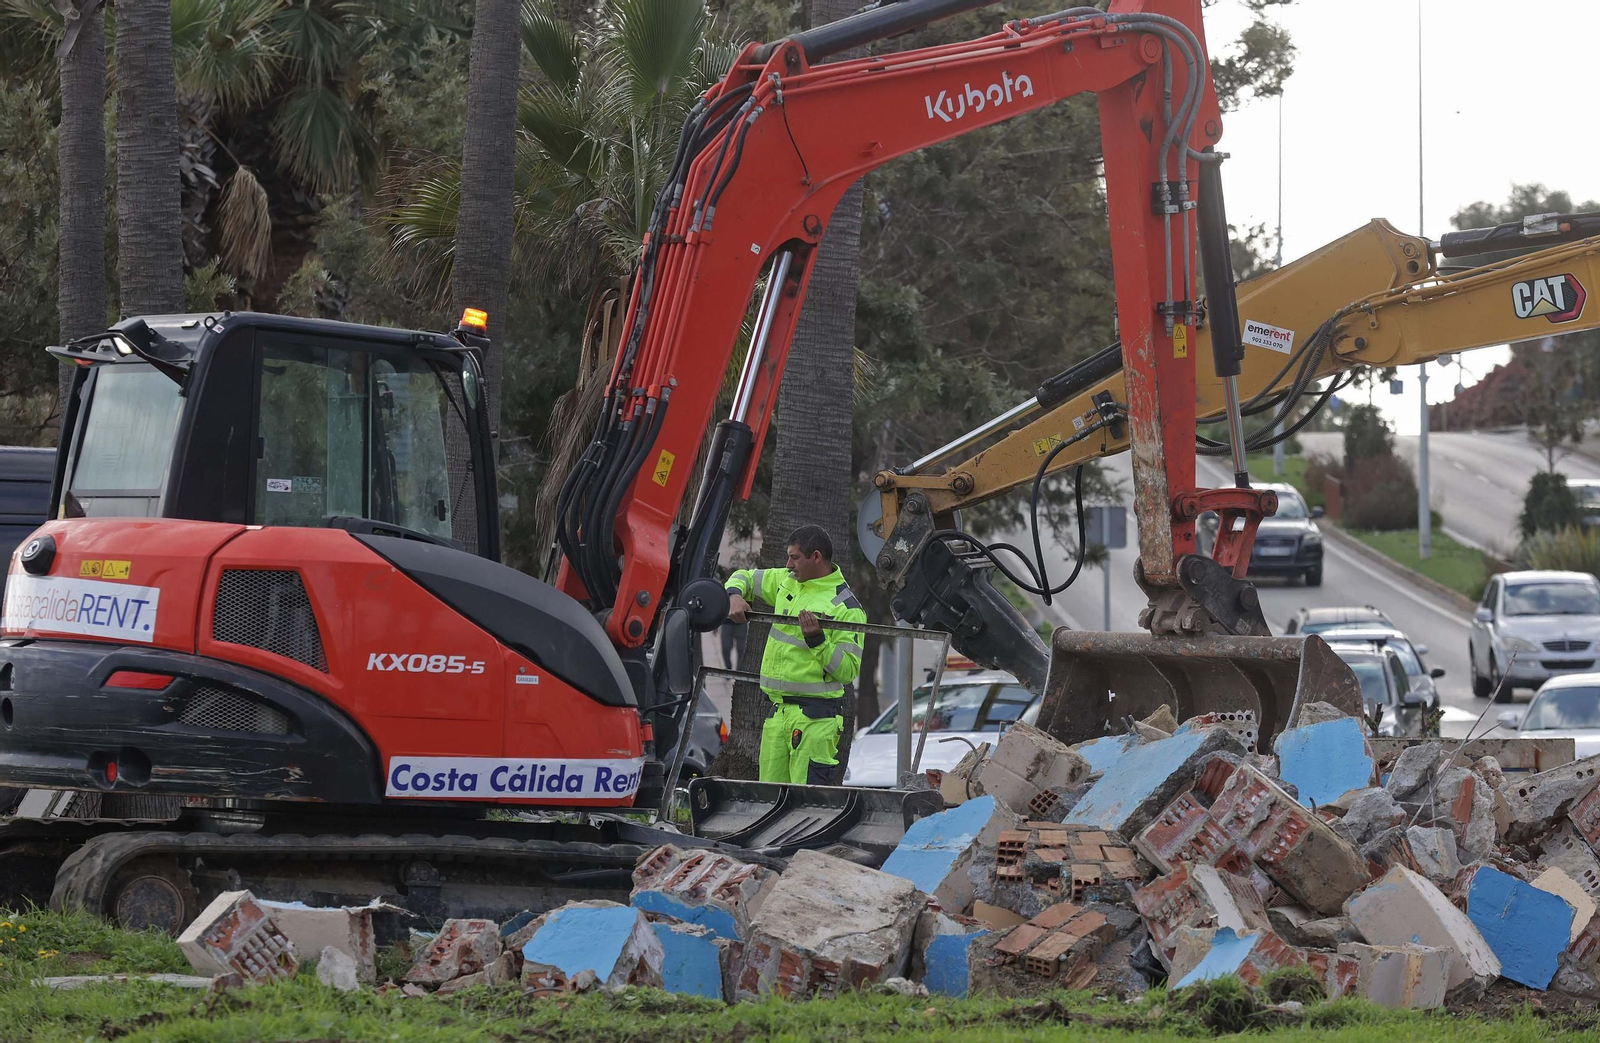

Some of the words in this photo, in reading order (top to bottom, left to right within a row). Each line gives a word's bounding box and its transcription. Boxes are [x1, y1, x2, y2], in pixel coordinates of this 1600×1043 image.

[924, 70, 1034, 123] Kubota
[1513, 276, 1566, 318] CAT
[1248, 324, 1291, 341] emerent
[366, 652, 485, 675] KX085-5
[391, 764, 478, 792] Costa
[490, 764, 583, 794] Cálida
